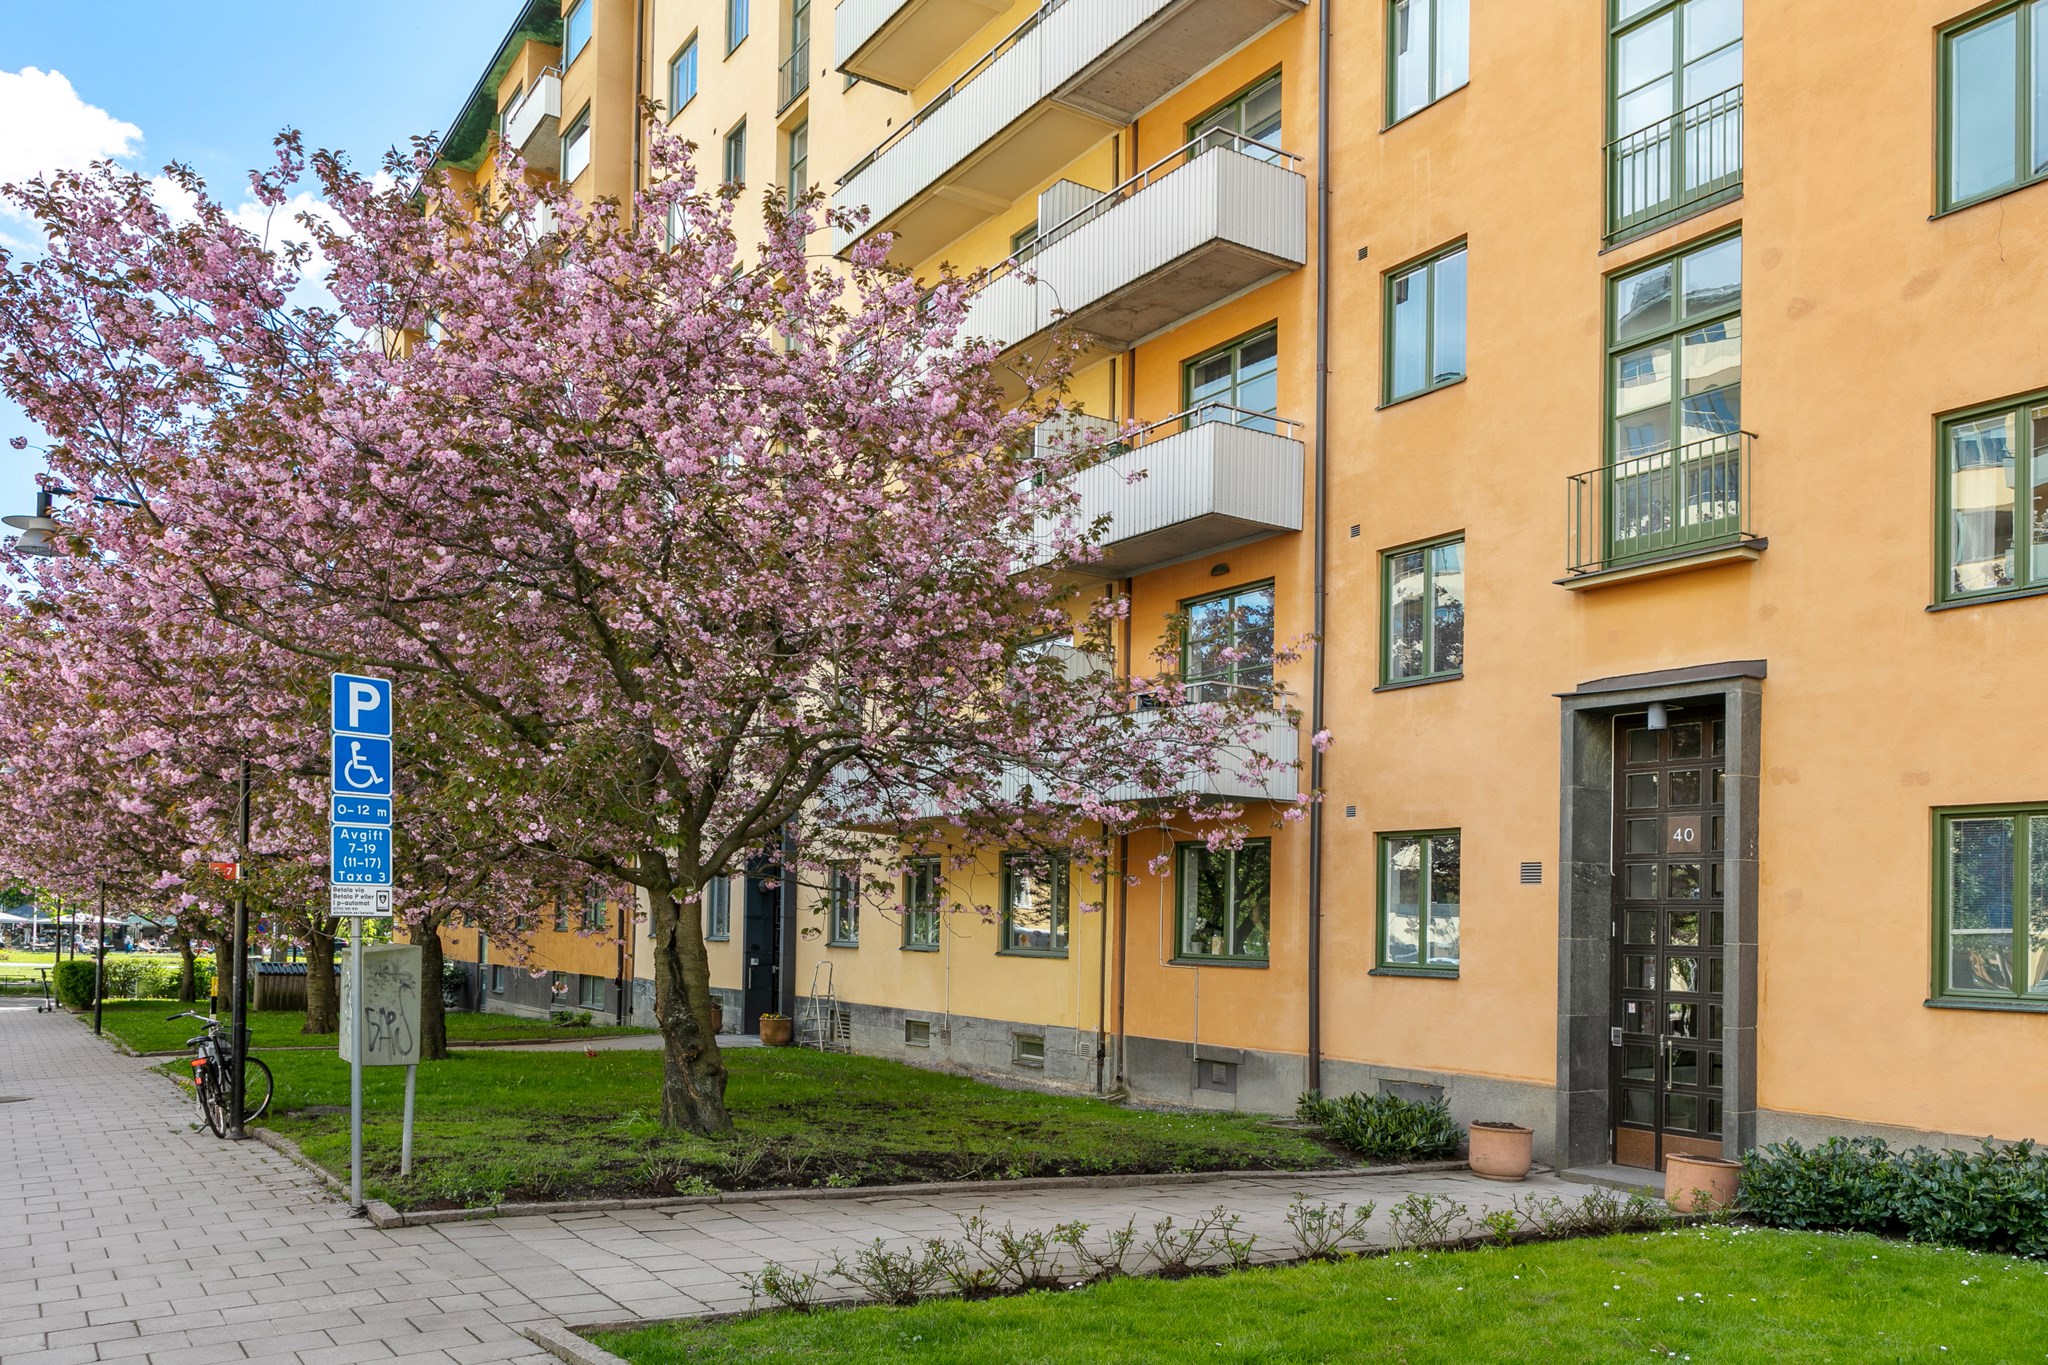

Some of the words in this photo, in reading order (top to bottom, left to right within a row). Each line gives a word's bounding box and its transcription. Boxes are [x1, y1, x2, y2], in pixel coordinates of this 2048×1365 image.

[349, 681, 381, 728] P
[337, 804, 370, 816] 0-12
[377, 808, 387, 817] m
[340, 829, 383, 842] Avgift
[1673, 827, 1695, 842] 40
[348, 843, 376, 854] 7-19
[343, 856, 381, 869] (11-17)
[338, 871, 372, 882] Taxa
[378, 872, 386, 882] 3
